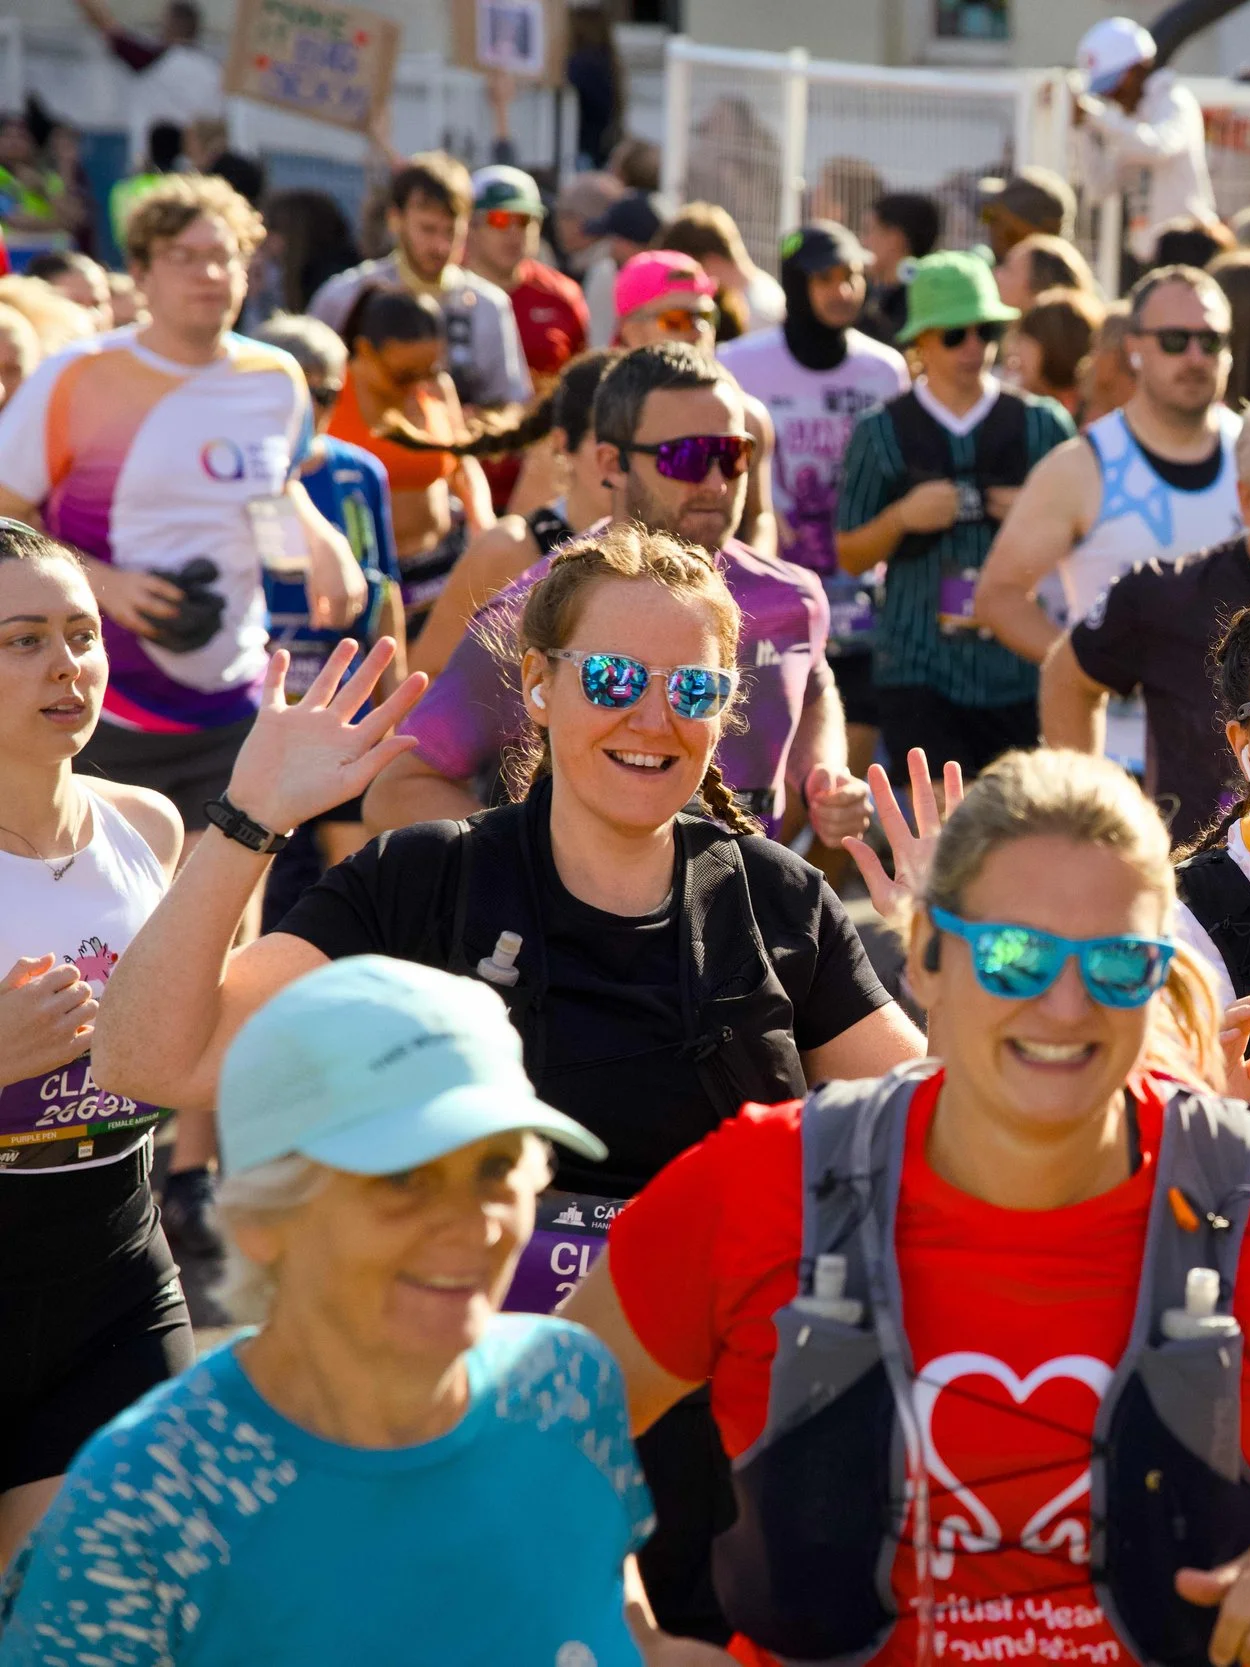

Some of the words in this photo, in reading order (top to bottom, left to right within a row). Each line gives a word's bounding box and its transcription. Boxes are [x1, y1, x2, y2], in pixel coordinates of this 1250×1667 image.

[35, 1095, 137, 1127] 26634
[107, 1118, 134, 1130] FEMALE
[11, 1133, 41, 1144] PURPLE
[42, 1131, 57, 1141] PEN
